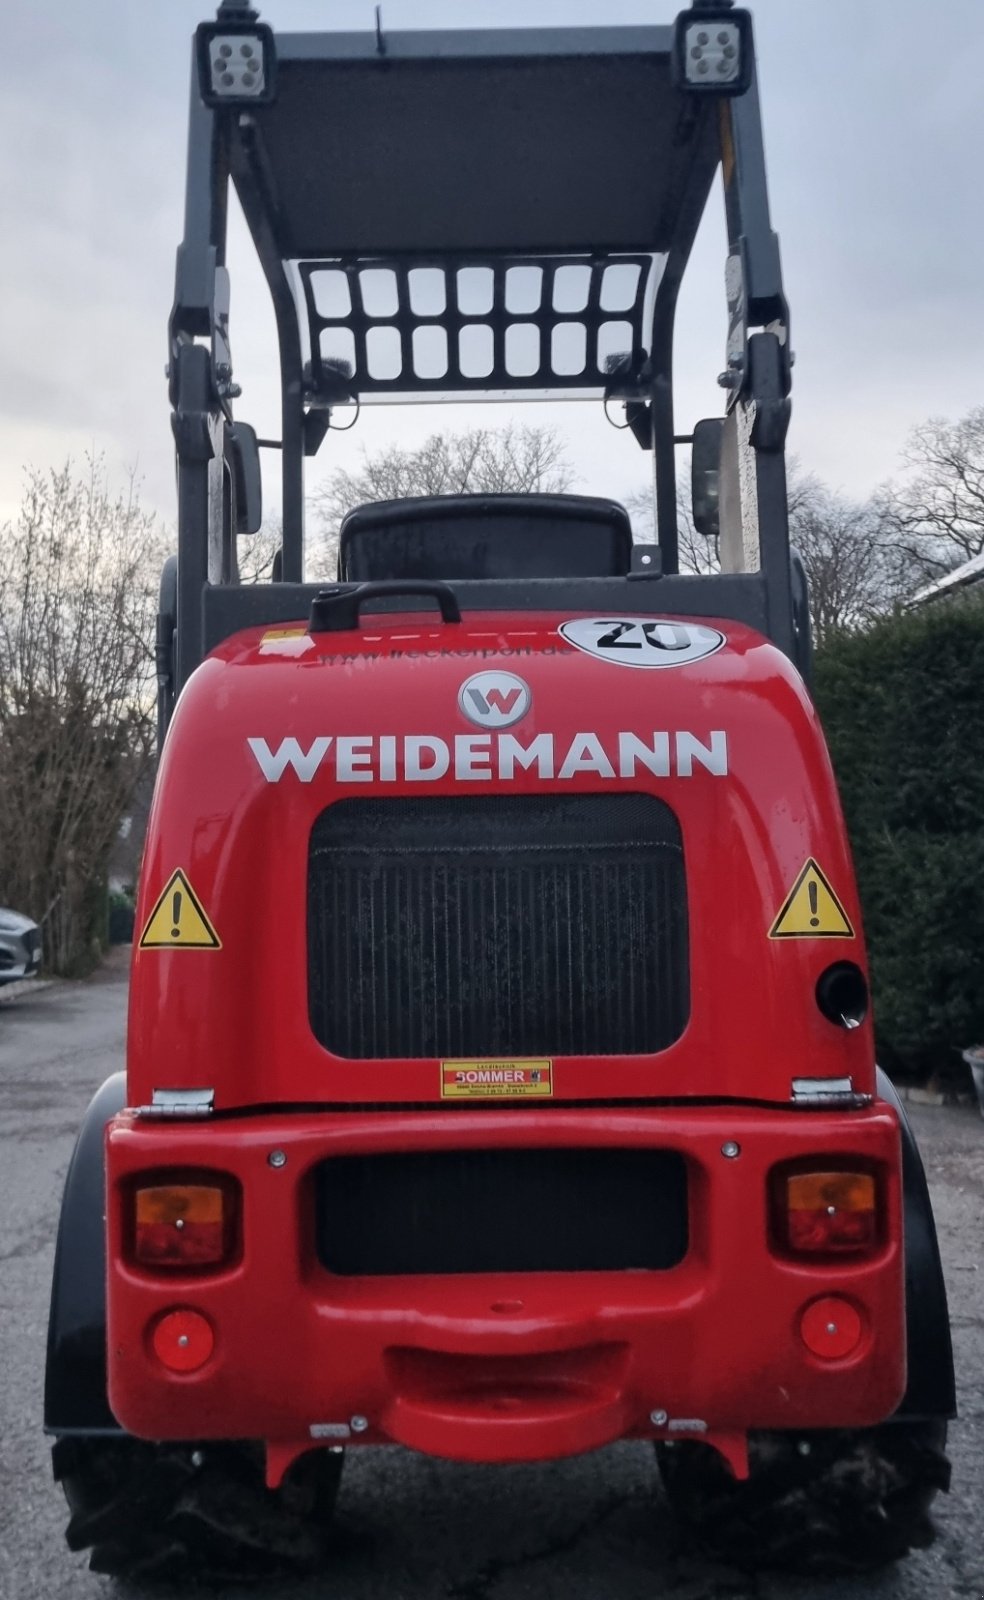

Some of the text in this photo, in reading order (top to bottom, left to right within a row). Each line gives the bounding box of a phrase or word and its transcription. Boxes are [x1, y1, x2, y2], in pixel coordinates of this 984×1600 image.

[593, 621, 691, 651] 20
[247, 731, 728, 782] WEIDEMANN
[455, 1070, 525, 1083] SOMMER
